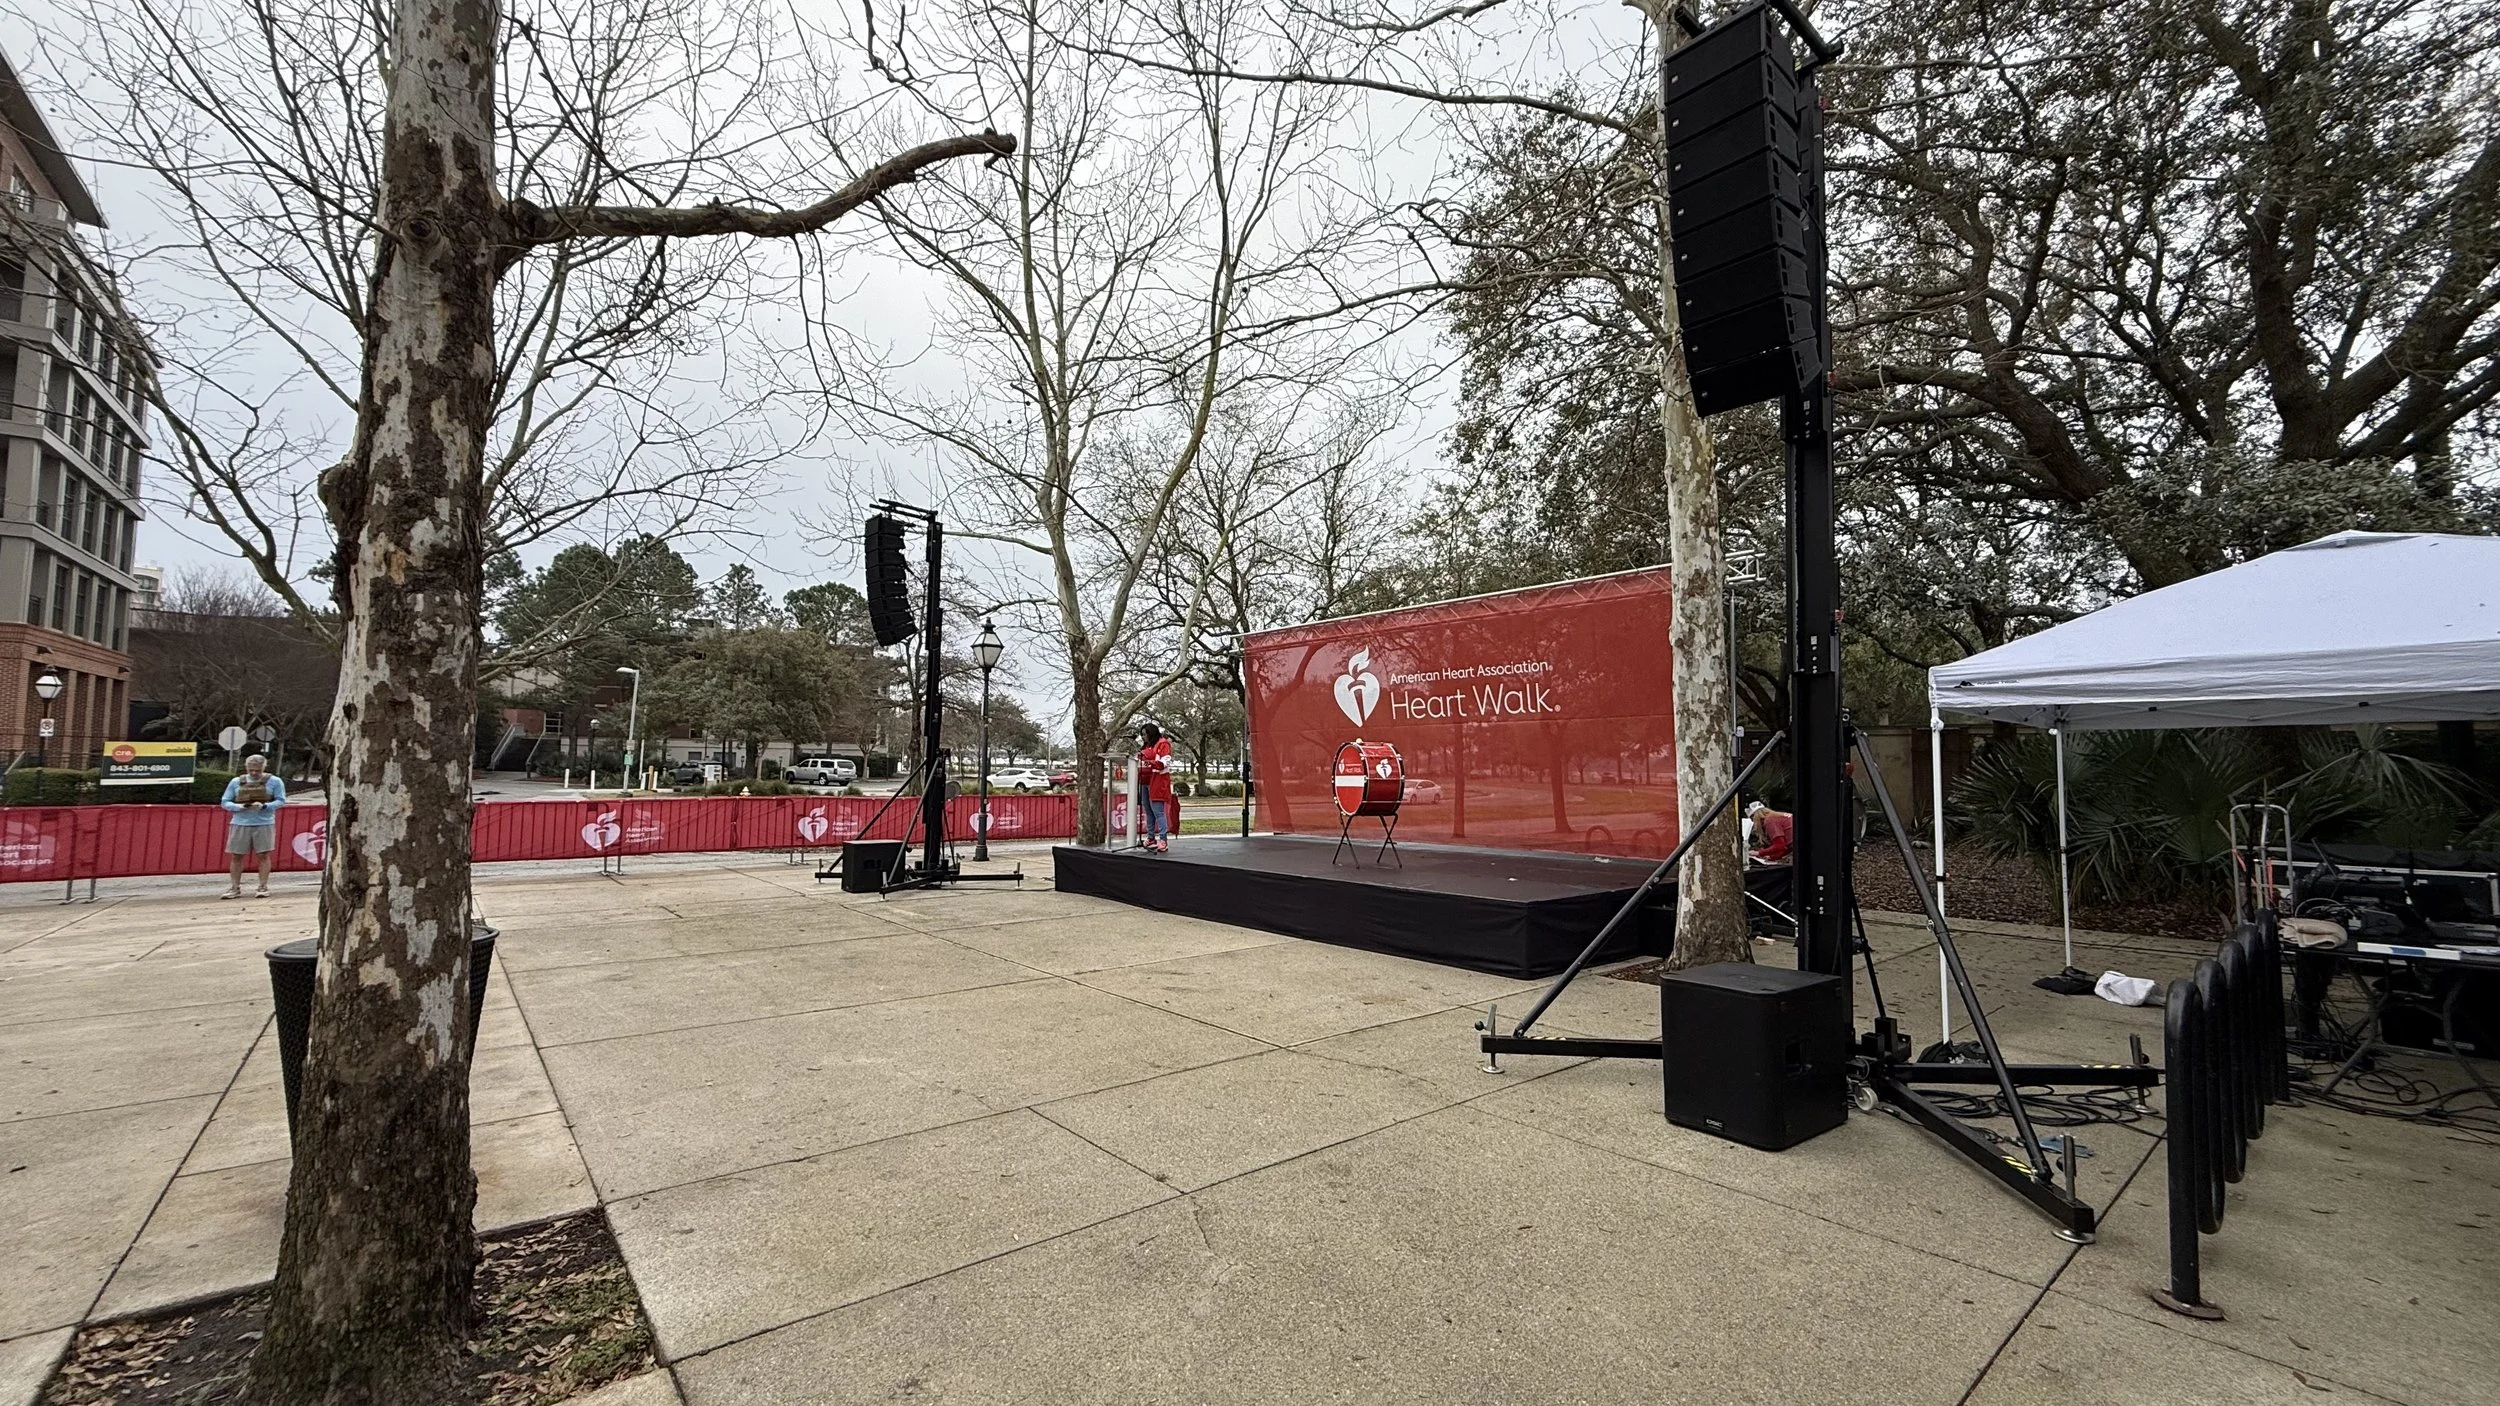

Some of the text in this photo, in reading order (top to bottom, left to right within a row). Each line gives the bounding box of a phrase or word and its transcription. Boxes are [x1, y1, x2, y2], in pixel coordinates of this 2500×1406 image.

[1390, 672, 1440, 685] American
[1442, 665, 1475, 680] Heart
[1390, 688, 1468, 720] Heart
